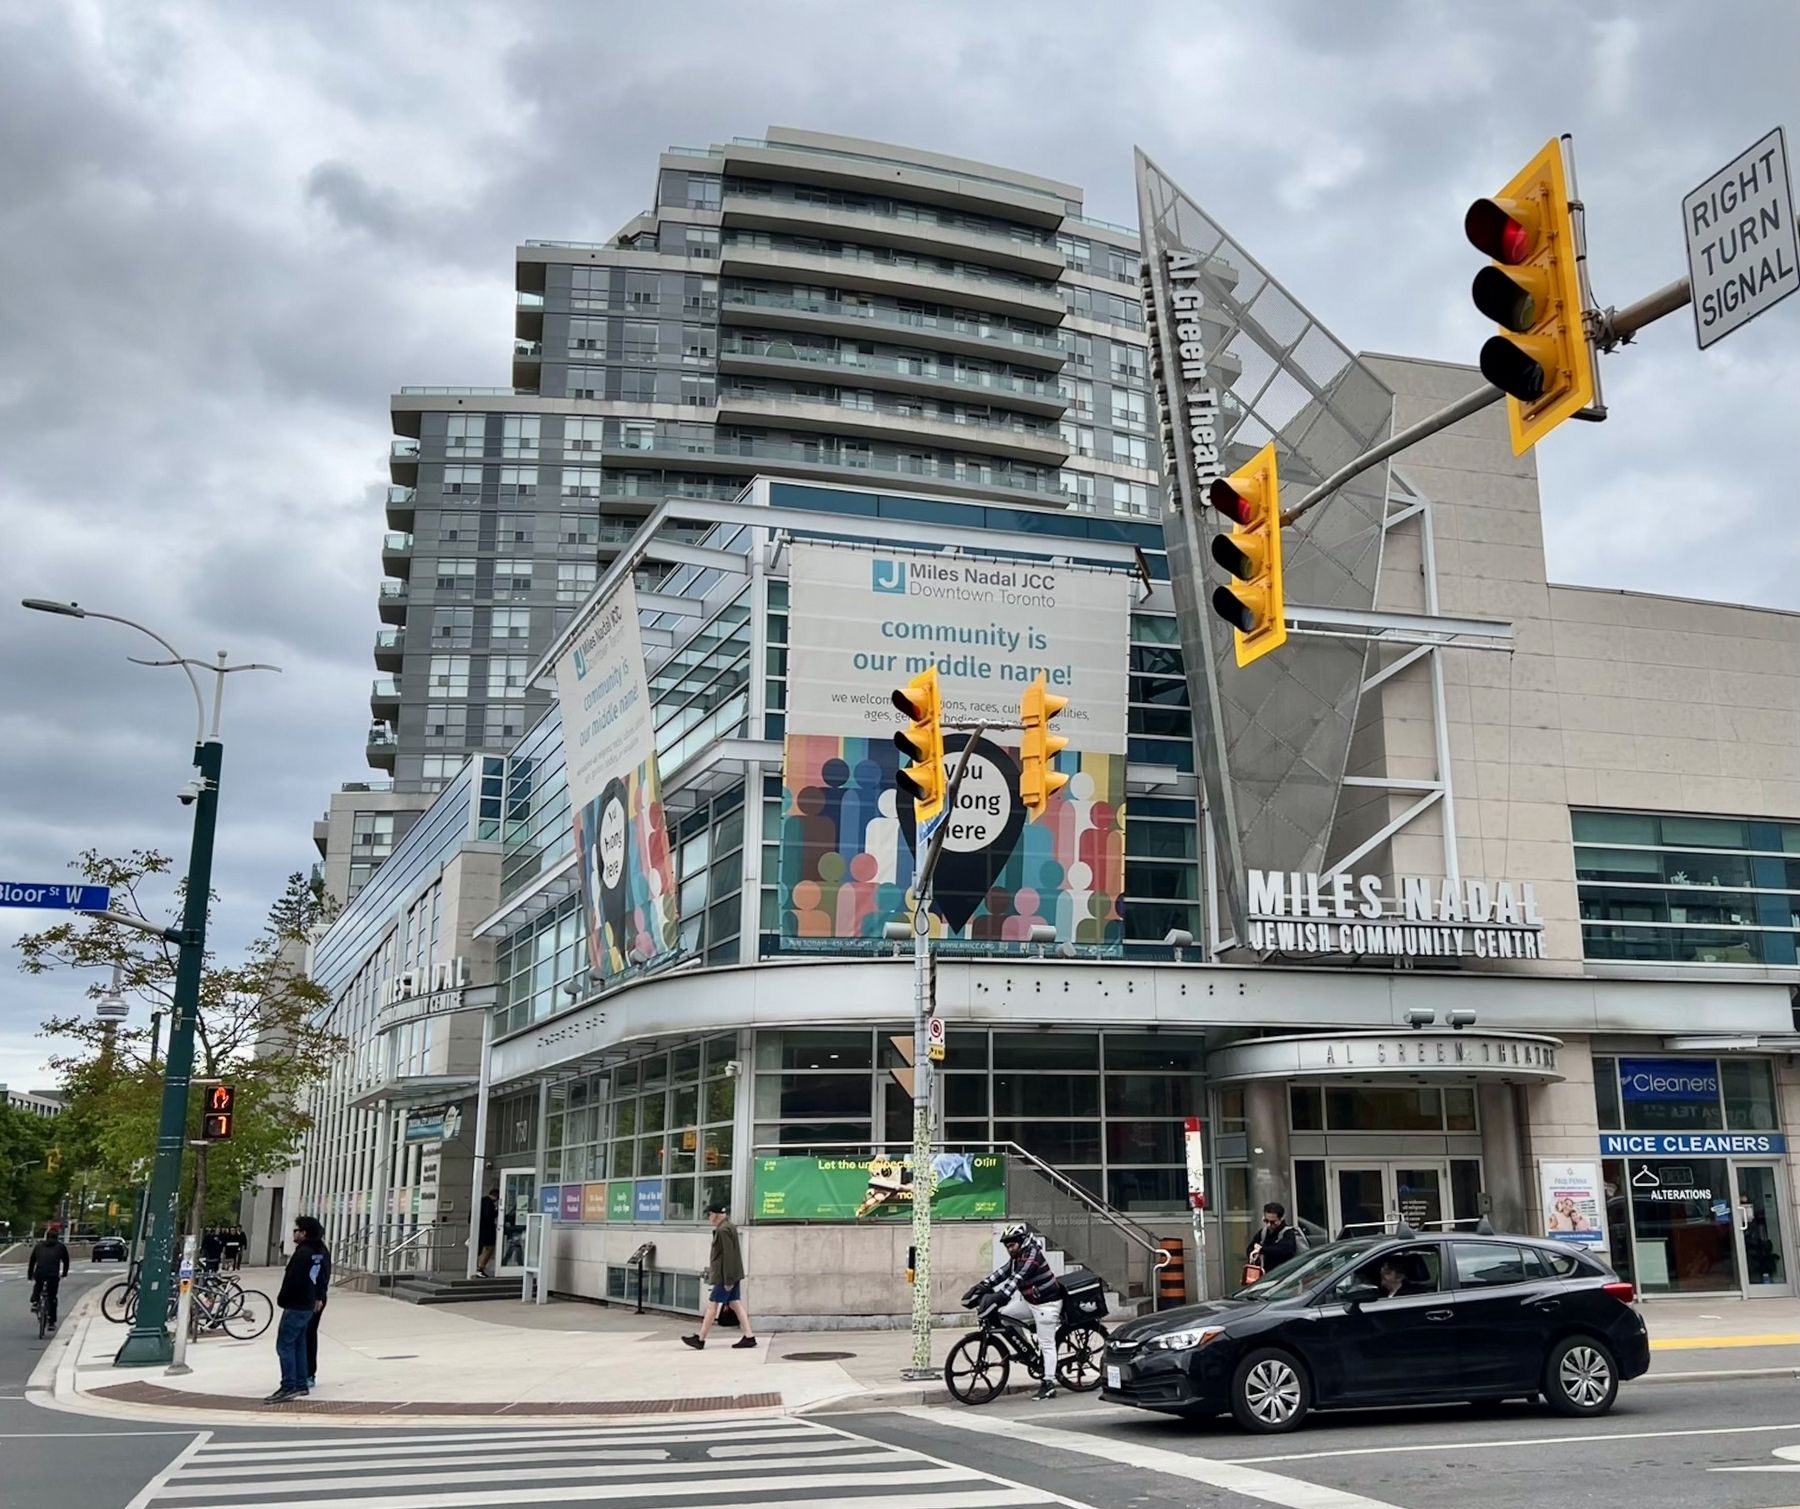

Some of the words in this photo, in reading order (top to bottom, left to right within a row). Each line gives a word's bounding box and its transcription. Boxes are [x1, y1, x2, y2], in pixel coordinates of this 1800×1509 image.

[1692, 148, 1775, 236] RIGHT
[1701, 198, 1780, 276] TURN
[1166, 250, 1201, 281] Al
[1703, 248, 1794, 327] SIGNAL
[1172, 290, 1208, 380] Green
[910, 563, 959, 582] Miles
[964, 568, 1016, 587] Nadal
[1021, 574, 1056, 590] JCC
[910, 581, 994, 603] Downtown
[999, 589, 1056, 608] Toronto
[881, 619, 1020, 653] community
[1028, 626, 1047, 649] is
[854, 653, 897, 671] our
[905, 651, 991, 679] middle
[831, 693, 848, 704] we
[850, 692, 893, 706] welcom
[970, 702, 999, 713] races,
[864, 709, 892, 723] ages,
[49, 886, 60, 896] St
[66, 886, 83, 904] W
[1248, 869, 1382, 919] MILES
[1402, 878, 1544, 925] NADAL
[1249, 921, 1330, 953] JEWISH
[1340, 924, 1463, 956] COMMUNITY
[1473, 929, 1549, 959] CENTRE
[1327, 1044, 1353, 1064] AL
[1377, 1043, 1464, 1064] GREEN
[1633, 1073, 1717, 1093] Cleaners
[1608, 1136, 1657, 1152] NICE
[1663, 1136, 1770, 1152] CLEANERS
[818, 1159, 841, 1171] Let
[842, 1159, 856, 1170] the
[1651, 1189, 1712, 1201] ALTERATIONS
